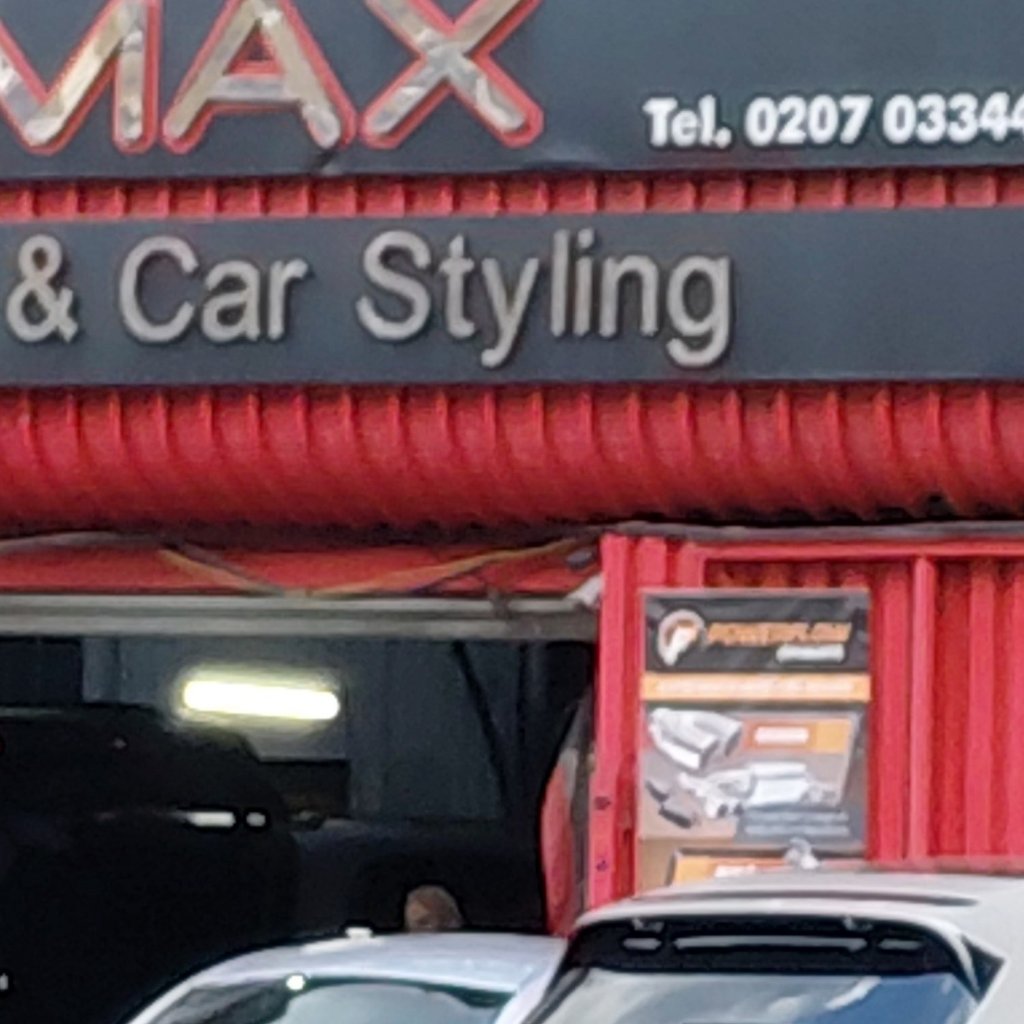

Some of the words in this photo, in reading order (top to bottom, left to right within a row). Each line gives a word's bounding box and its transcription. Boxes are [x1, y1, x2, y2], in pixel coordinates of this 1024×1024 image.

[643, 96, 732, 148] Tel.
[744, 94, 871, 145] 0207
[6, 234, 78, 343] &
[118, 234, 308, 343] Car
[356, 229, 732, 367] Styling
